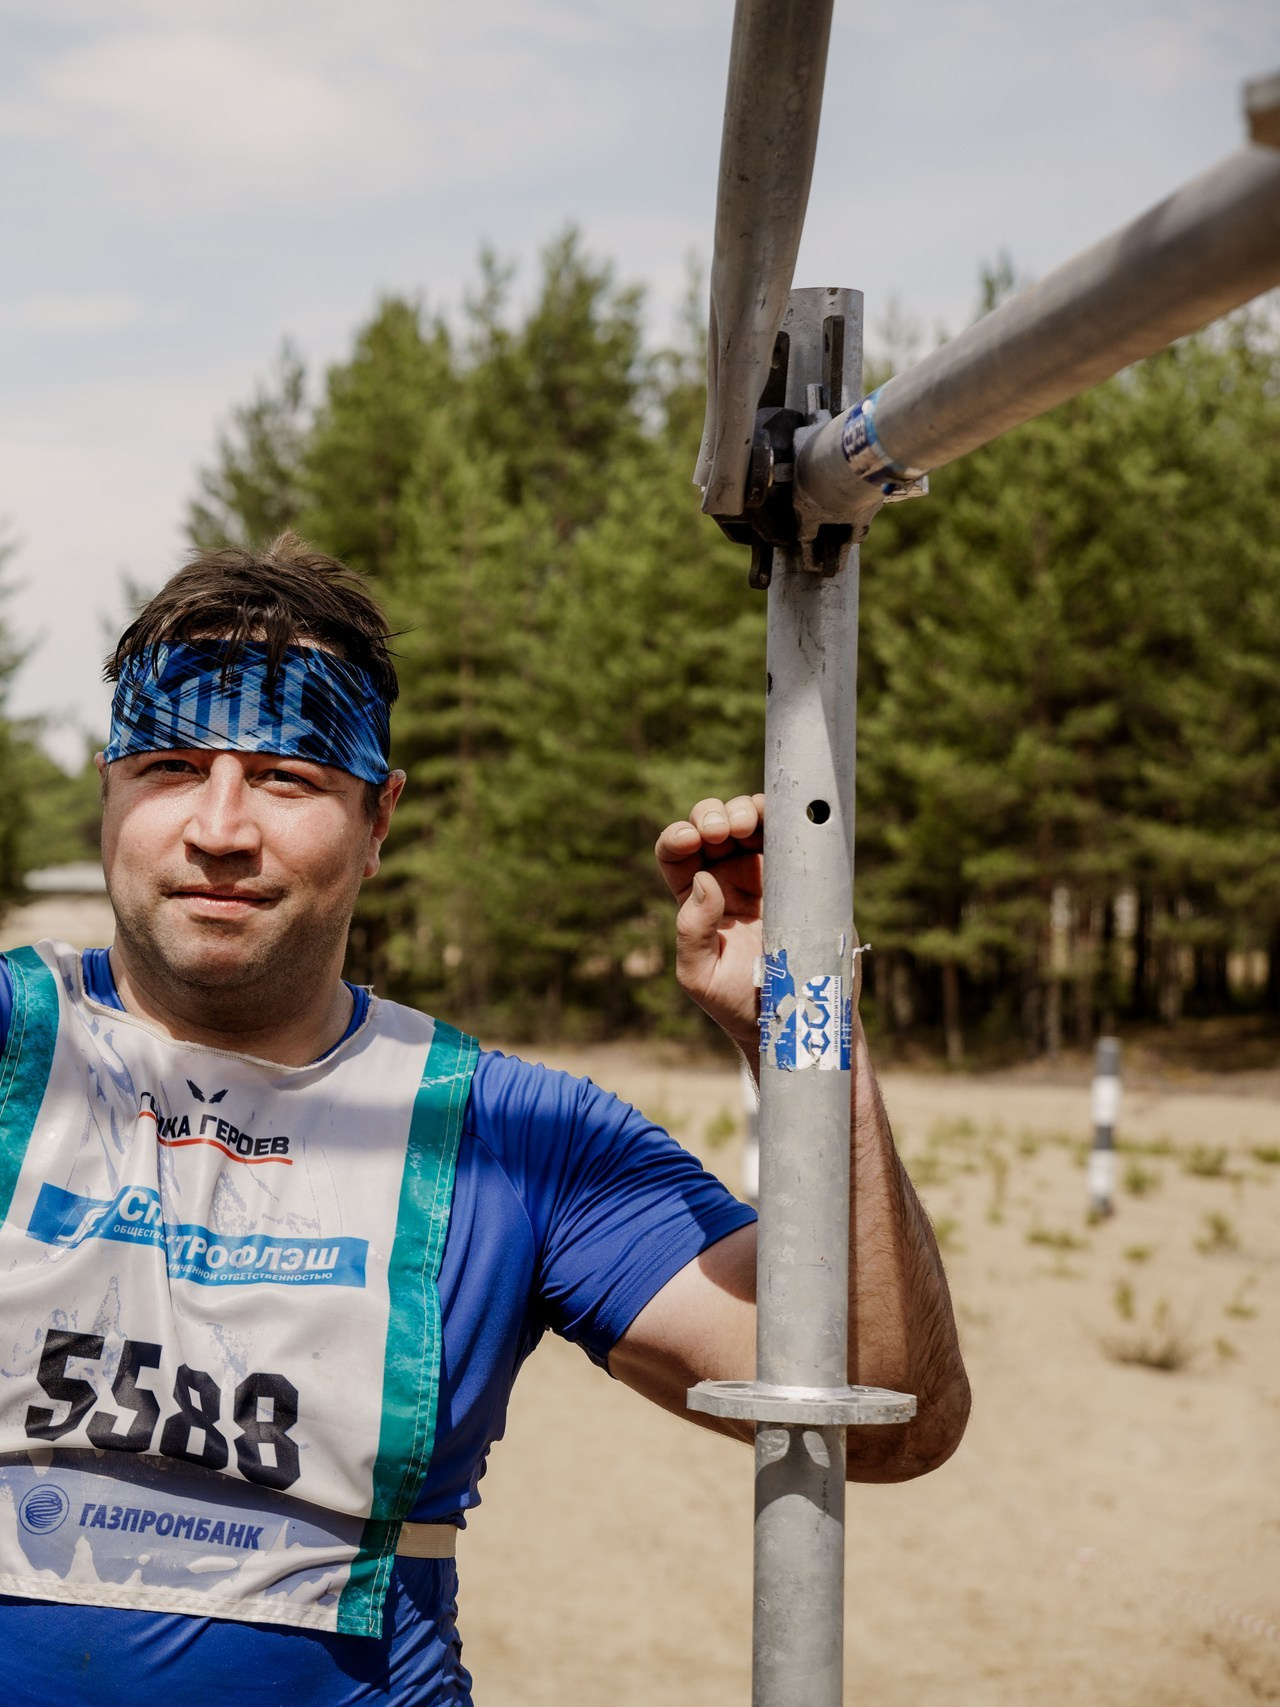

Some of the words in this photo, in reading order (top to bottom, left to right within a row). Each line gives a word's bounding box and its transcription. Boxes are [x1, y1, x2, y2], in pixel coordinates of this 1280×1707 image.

[199, 1114, 290, 1156] ГЕРОЕВ
[219, 1271, 333, 1282] ОТВЕТСТВЕННОСТЬЮ
[24, 1328, 302, 1491] 5588
[78, 1503, 265, 1551] ГАЗПРОМБАНК
